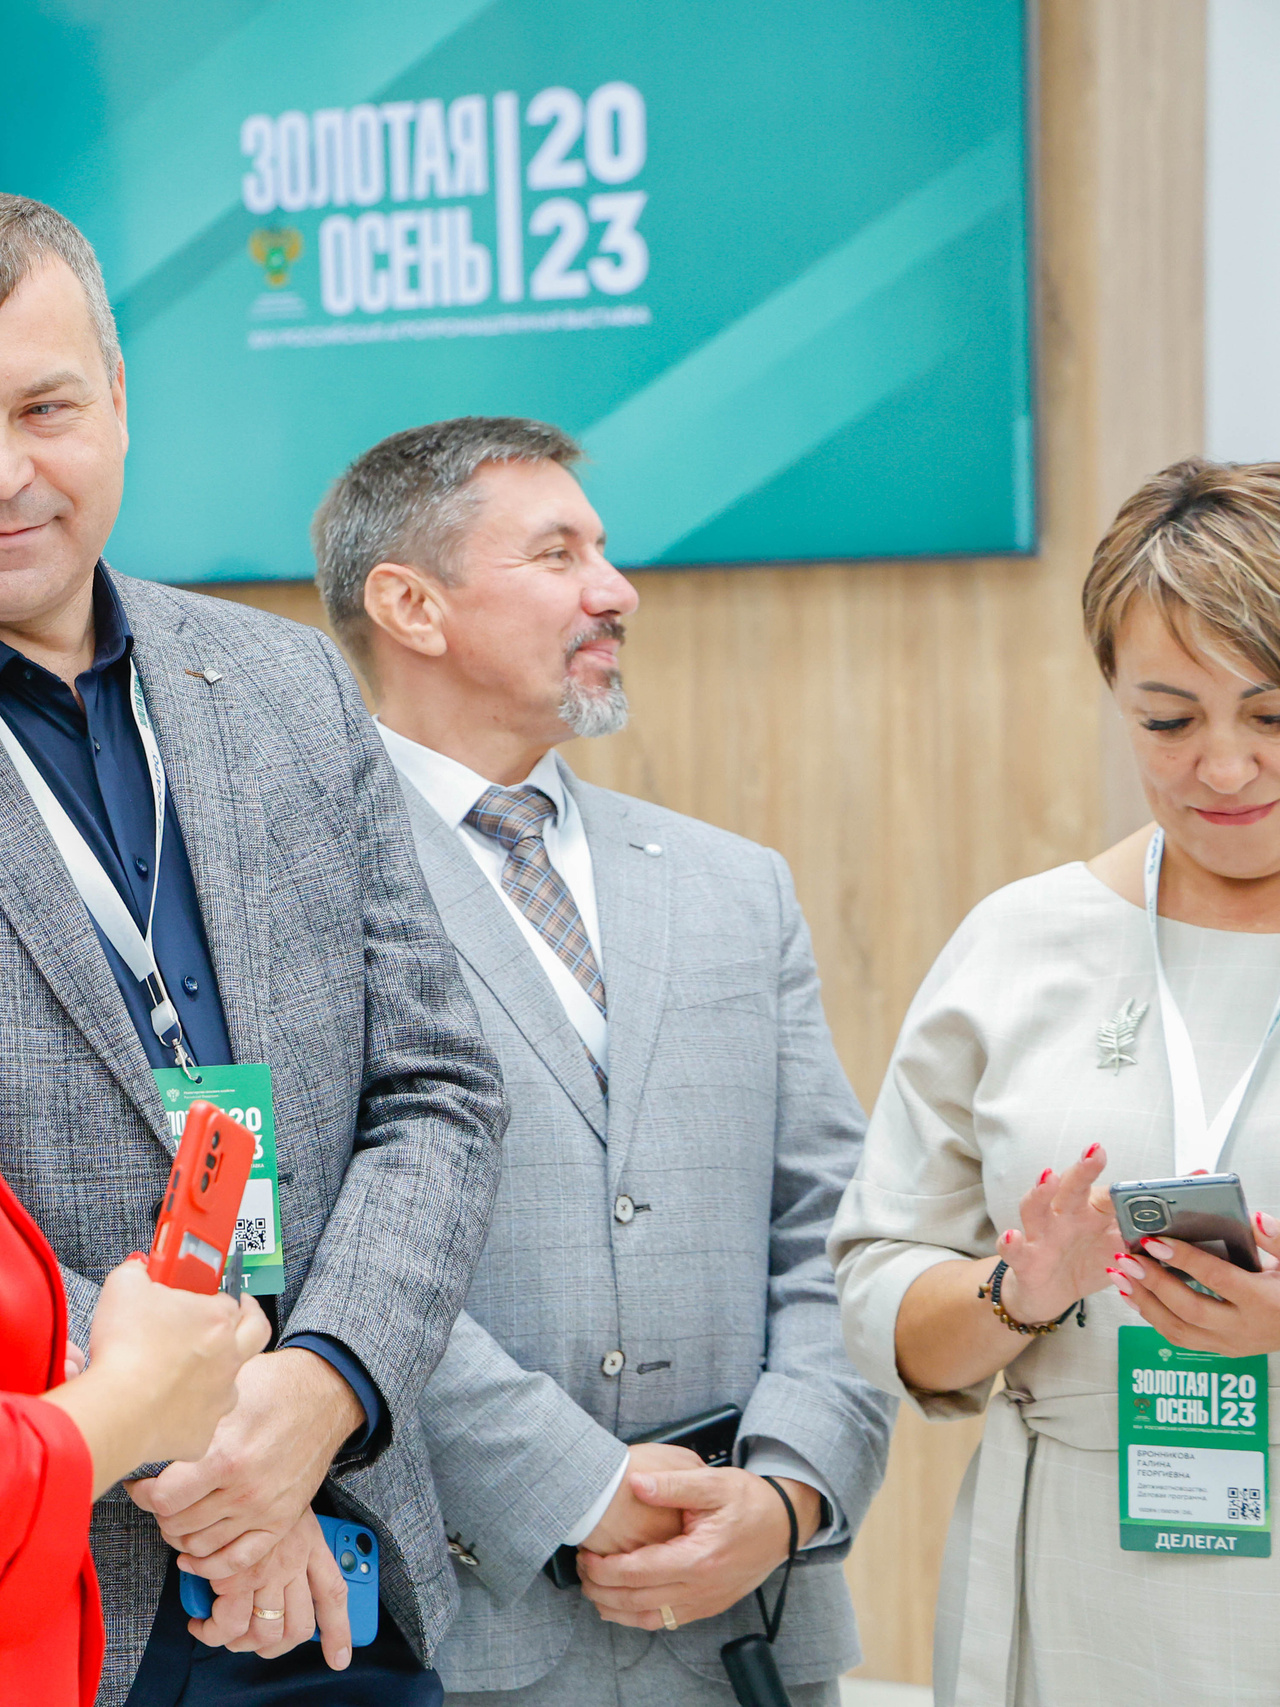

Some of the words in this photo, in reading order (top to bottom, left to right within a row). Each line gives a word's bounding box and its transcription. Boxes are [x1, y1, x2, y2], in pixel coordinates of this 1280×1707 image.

[525, 81, 647, 191] 20
[240, 93, 489, 214] ЗОЛОТАЯ
[528, 190, 649, 300] 23
[318, 206, 492, 316] ОСЕНЬ
[1132, 1368, 1209, 1397] ЗОЛОТАЯ
[1220, 1373, 1256, 1399] 20
[1155, 1397, 1210, 1425] ОСЕНЬ
[1220, 1401, 1256, 1427] 23
[1137, 1450, 1195, 1460] БРОННИКОВА
[1137, 1460, 1171, 1468] ГАЛИНА
[1137, 1469, 1191, 1479] ГЕОРГИЕВНА
[1155, 1532, 1238, 1551] ДЕЛЕГАТ
